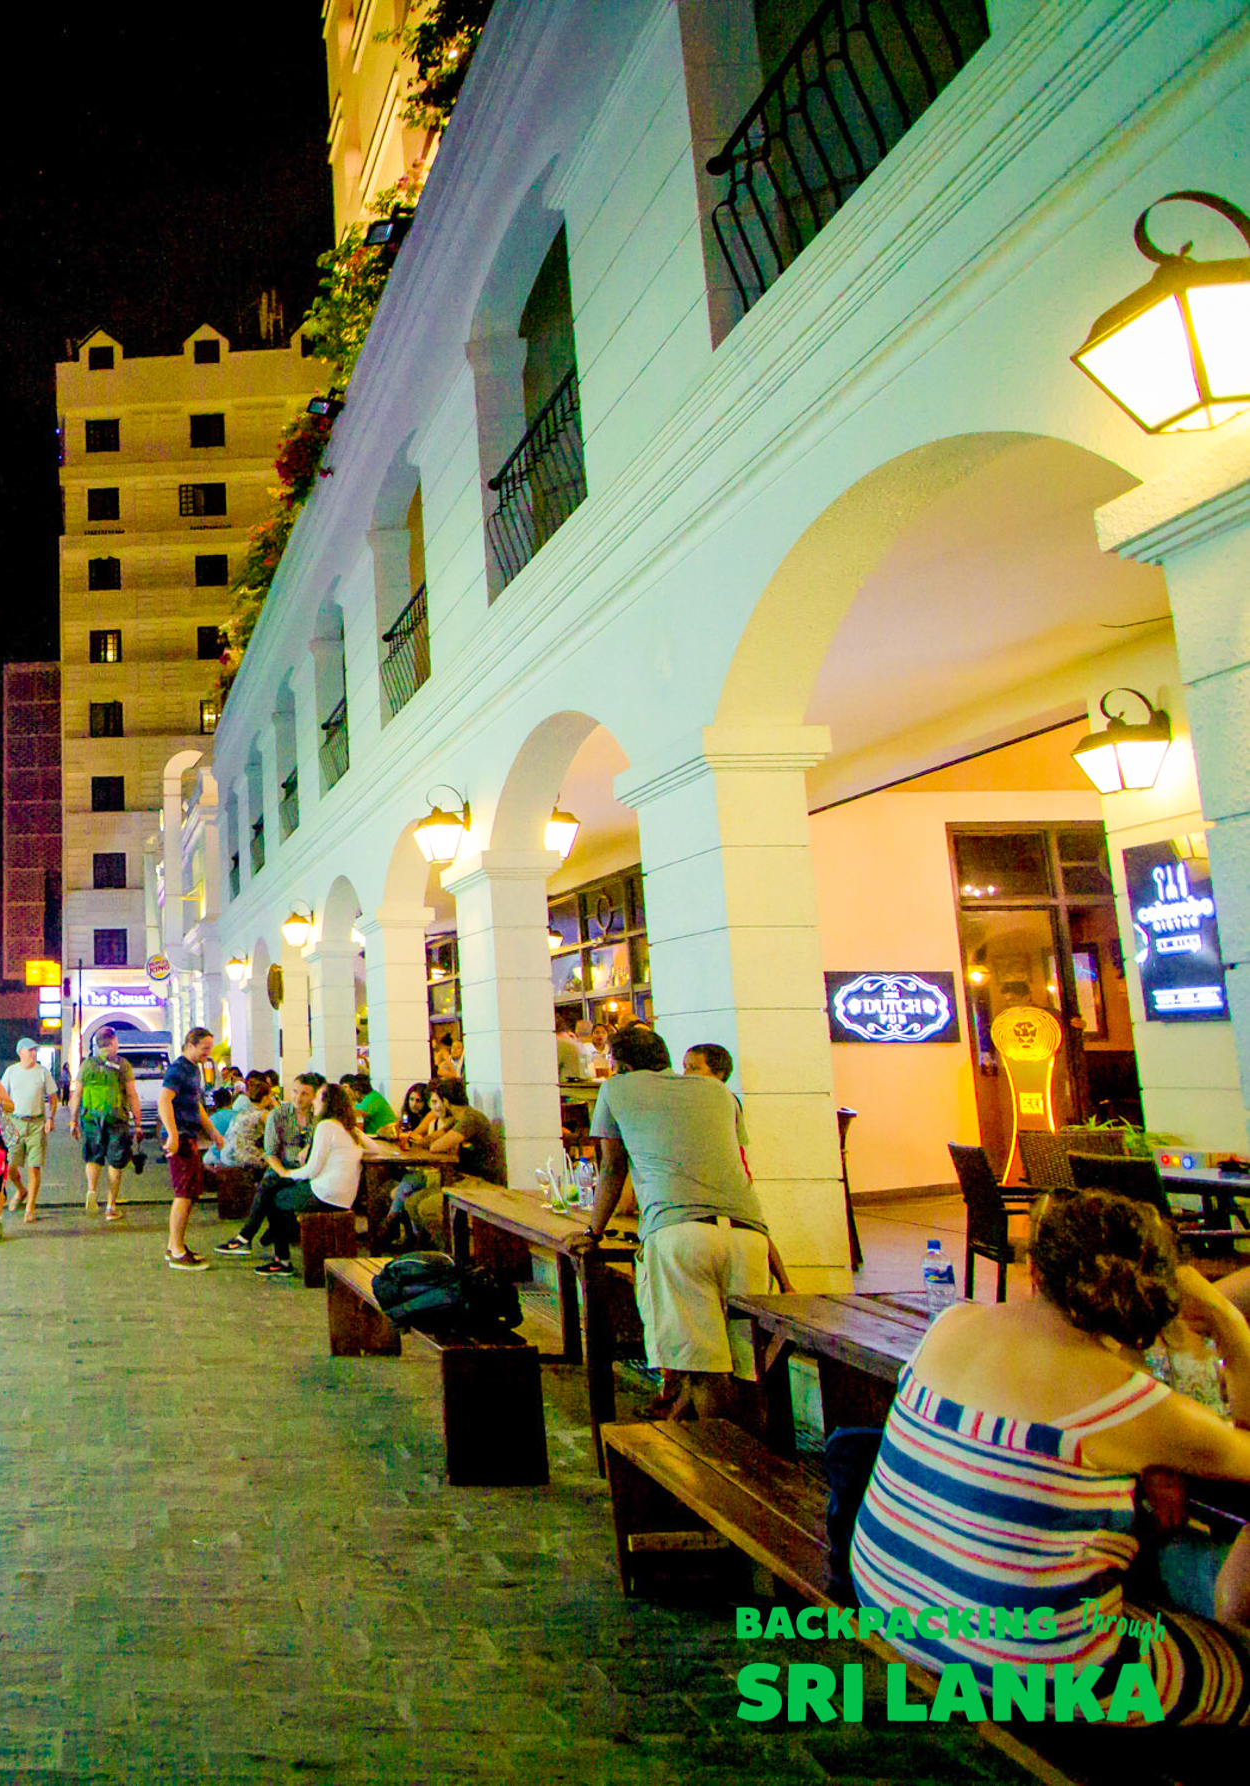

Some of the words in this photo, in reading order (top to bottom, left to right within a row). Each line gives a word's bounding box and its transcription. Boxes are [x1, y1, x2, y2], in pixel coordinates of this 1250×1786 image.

[83, 991, 107, 1005] The
[861, 999, 922, 1014] DUTCH
[880, 1013, 907, 1025] PUB
